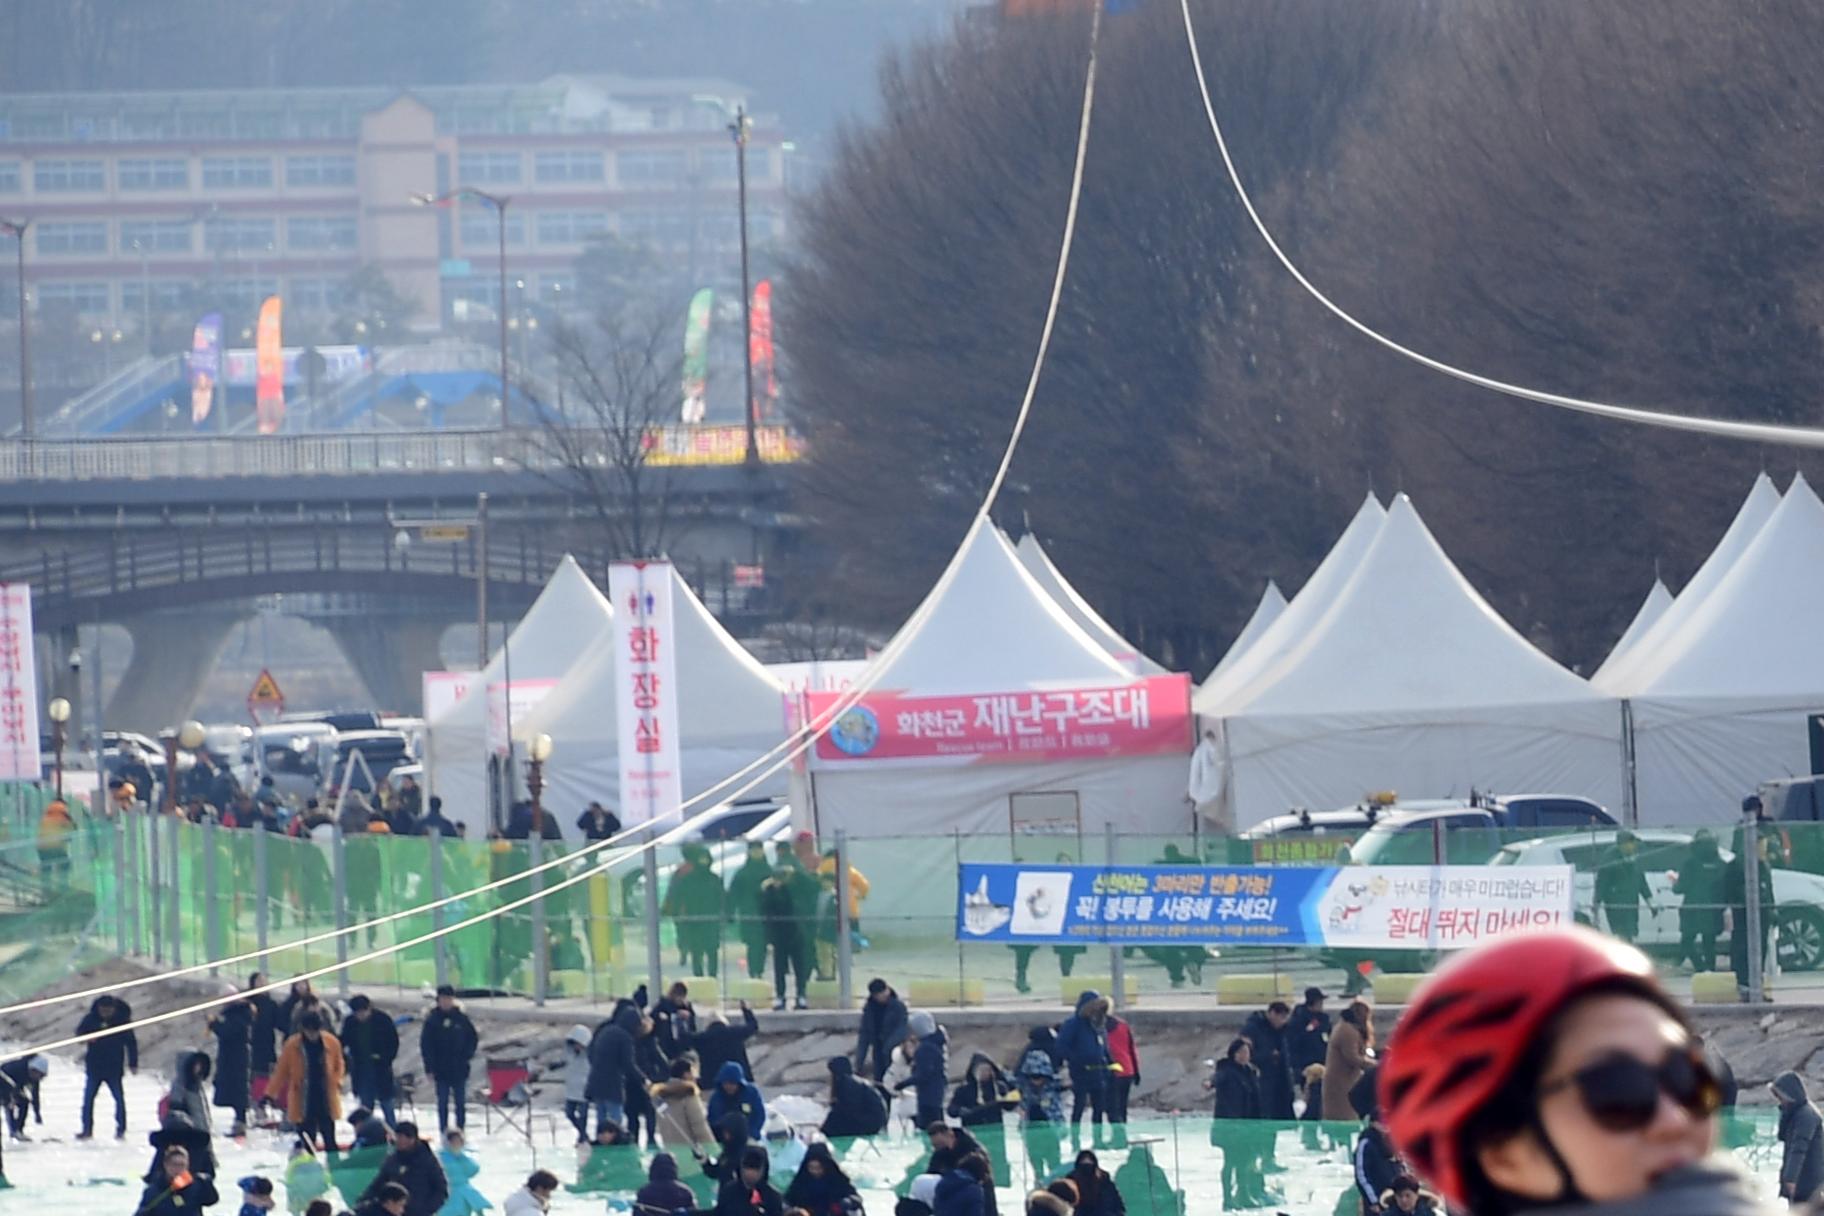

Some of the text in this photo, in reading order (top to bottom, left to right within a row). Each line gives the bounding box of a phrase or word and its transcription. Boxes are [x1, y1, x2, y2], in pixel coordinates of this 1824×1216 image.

[629, 626, 661, 754] 화장실
[896, 688, 1150, 738] 화천군 재난구조대
[1103, 896, 1154, 921] 봉투를
[1158, 896, 1213, 921] 사용해
[1216, 896, 1277, 921] 주세요!
[1387, 908, 1431, 939] 절대
[1436, 908, 1480, 939] 뛰지
